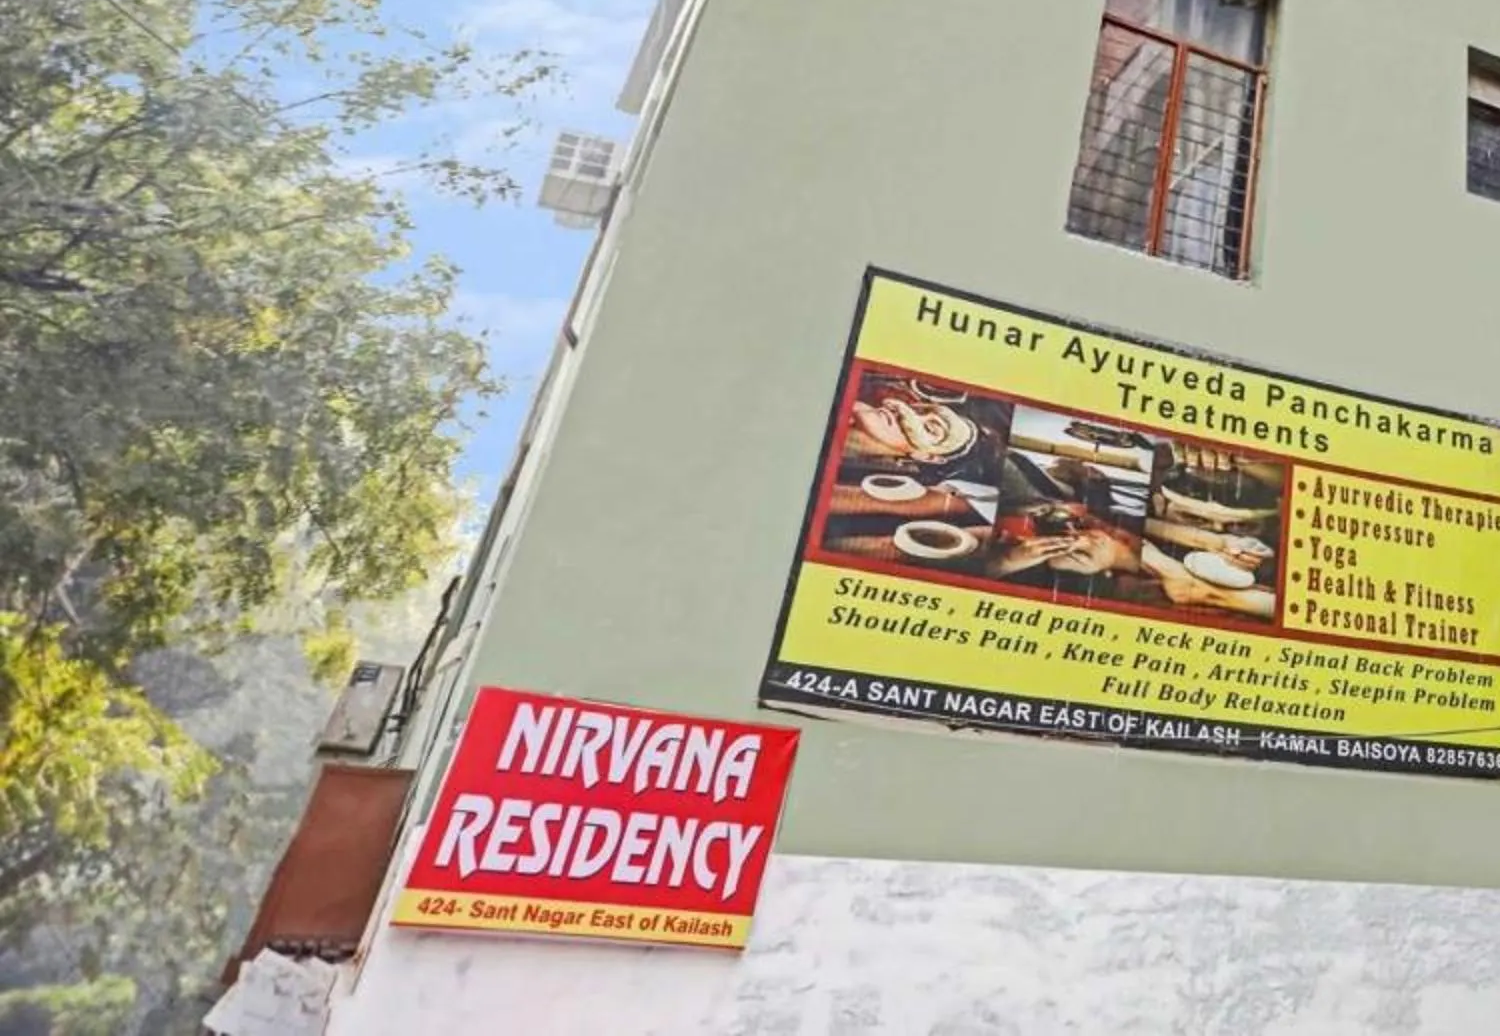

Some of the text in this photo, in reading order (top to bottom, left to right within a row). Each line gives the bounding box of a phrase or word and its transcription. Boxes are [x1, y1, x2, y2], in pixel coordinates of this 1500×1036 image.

[916, 295, 1494, 455] Hunar Ayurveda Panchakarma
[1117, 383, 1330, 452] Treatments
[1313, 477, 1414, 516] Ayurvedic
[1310, 537, 1357, 568] Yoga
[1311, 507, 1435, 548] Acupressure
[1307, 568, 1475, 615] Health & Fitness
[974, 600, 1042, 628] Head
[1136, 626, 1193, 651] Neck
[1278, 646, 1348, 671] Spinal
[1354, 656, 1404, 678] Back
[1410, 663, 1495, 688] Problem
[1305, 600, 1479, 646] Personal Trainer
[828, 606, 970, 645] Shoulders
[1062, 643, 1124, 668] Knee
[1327, 678, 1406, 705] Sleepin
[1413, 688, 1497, 712] Problem
[785, 671, 858, 700] 424-A
[867, 681, 937, 710] SANT
[943, 692, 1031, 722] NAGAR
[1039, 704, 1102, 731] EAST
[1108, 713, 1138, 734] OF
[1145, 716, 1241, 746] KAILASH
[1260, 731, 1330, 755] KAMAL
[1336, 739, 1421, 763] BAISOYA
[1101, 675, 1346, 722] Full Body Relaxation
[496, 701, 762, 803] NIRVANA
[435, 793, 763, 901] RESIDENCY
[417, 897, 733, 938] 424- Sant Nagar East of Kailash
